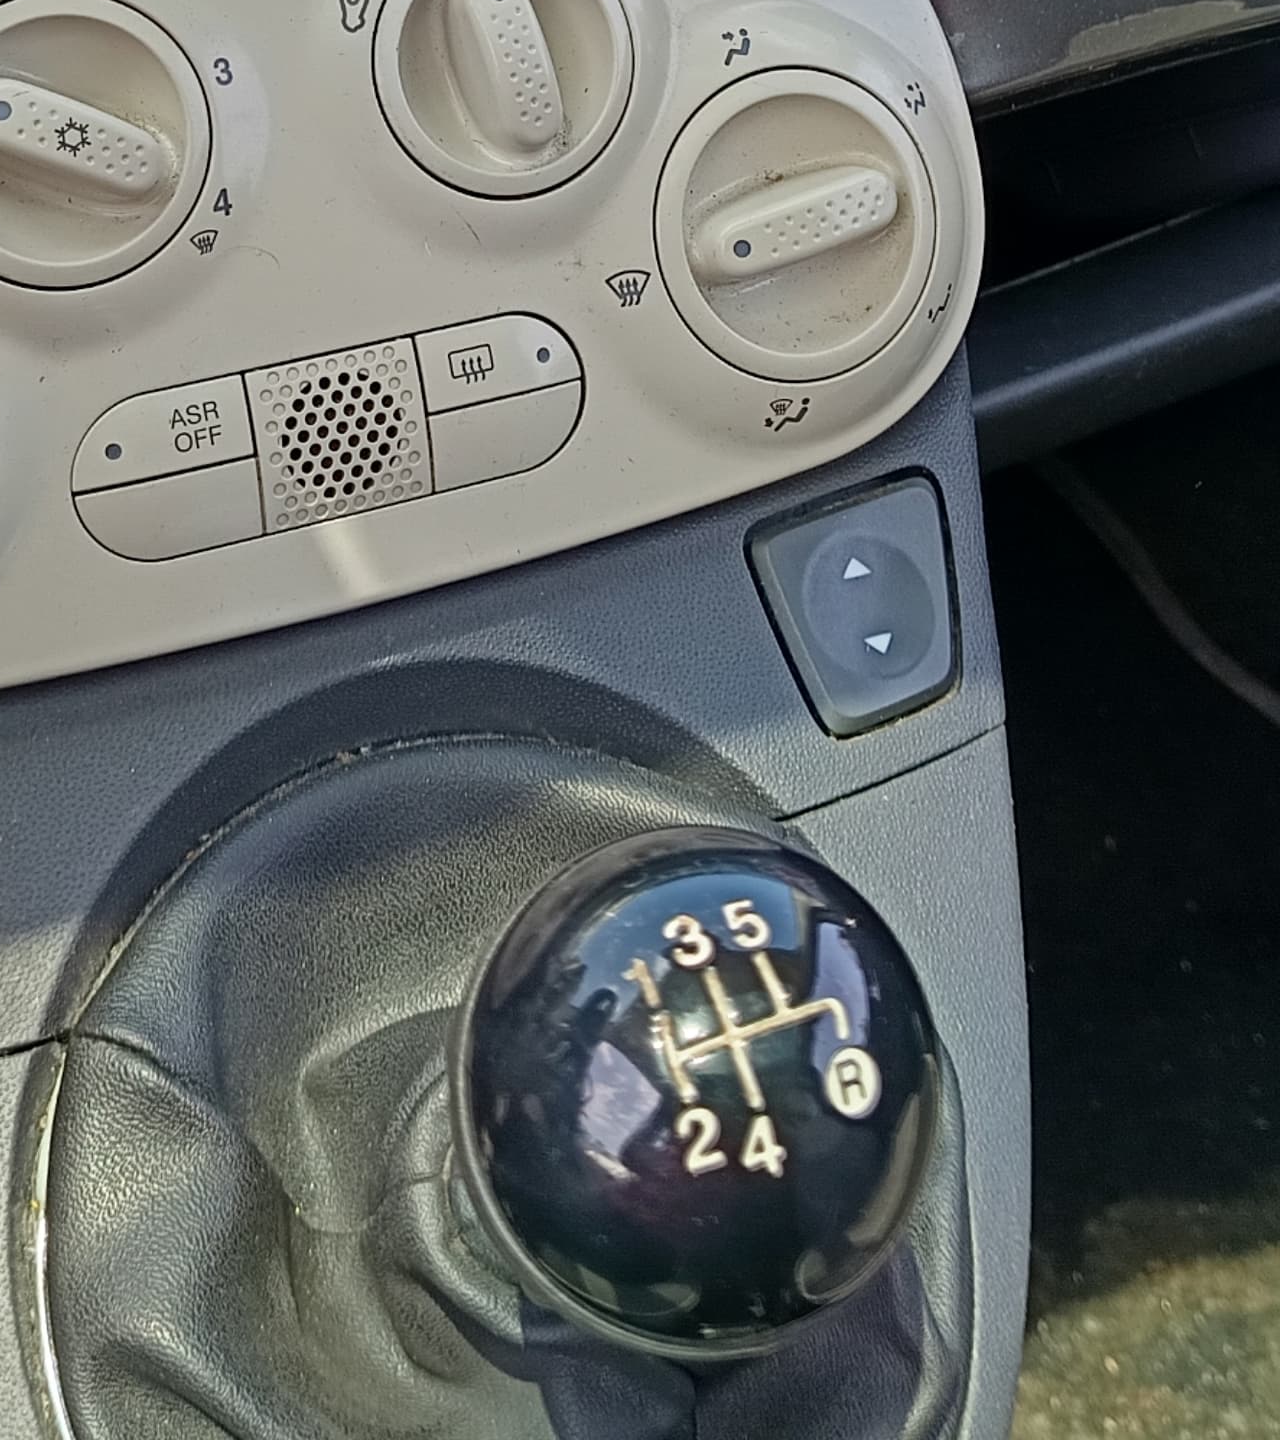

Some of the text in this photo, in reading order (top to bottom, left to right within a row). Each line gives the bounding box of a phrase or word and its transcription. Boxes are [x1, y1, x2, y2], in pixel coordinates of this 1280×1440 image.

[213, 57, 233, 86] 3
[212, 188, 232, 217] 4
[171, 401, 219, 430] ASR
[174, 424, 222, 453] OFF
[662, 914, 716, 969] 3
[722, 899, 770, 949] 5
[622, 957, 661, 1008] 1
[835, 1059, 868, 1106] R
[676, 1107, 727, 1176] 2
[740, 1115, 787, 1178] 4
